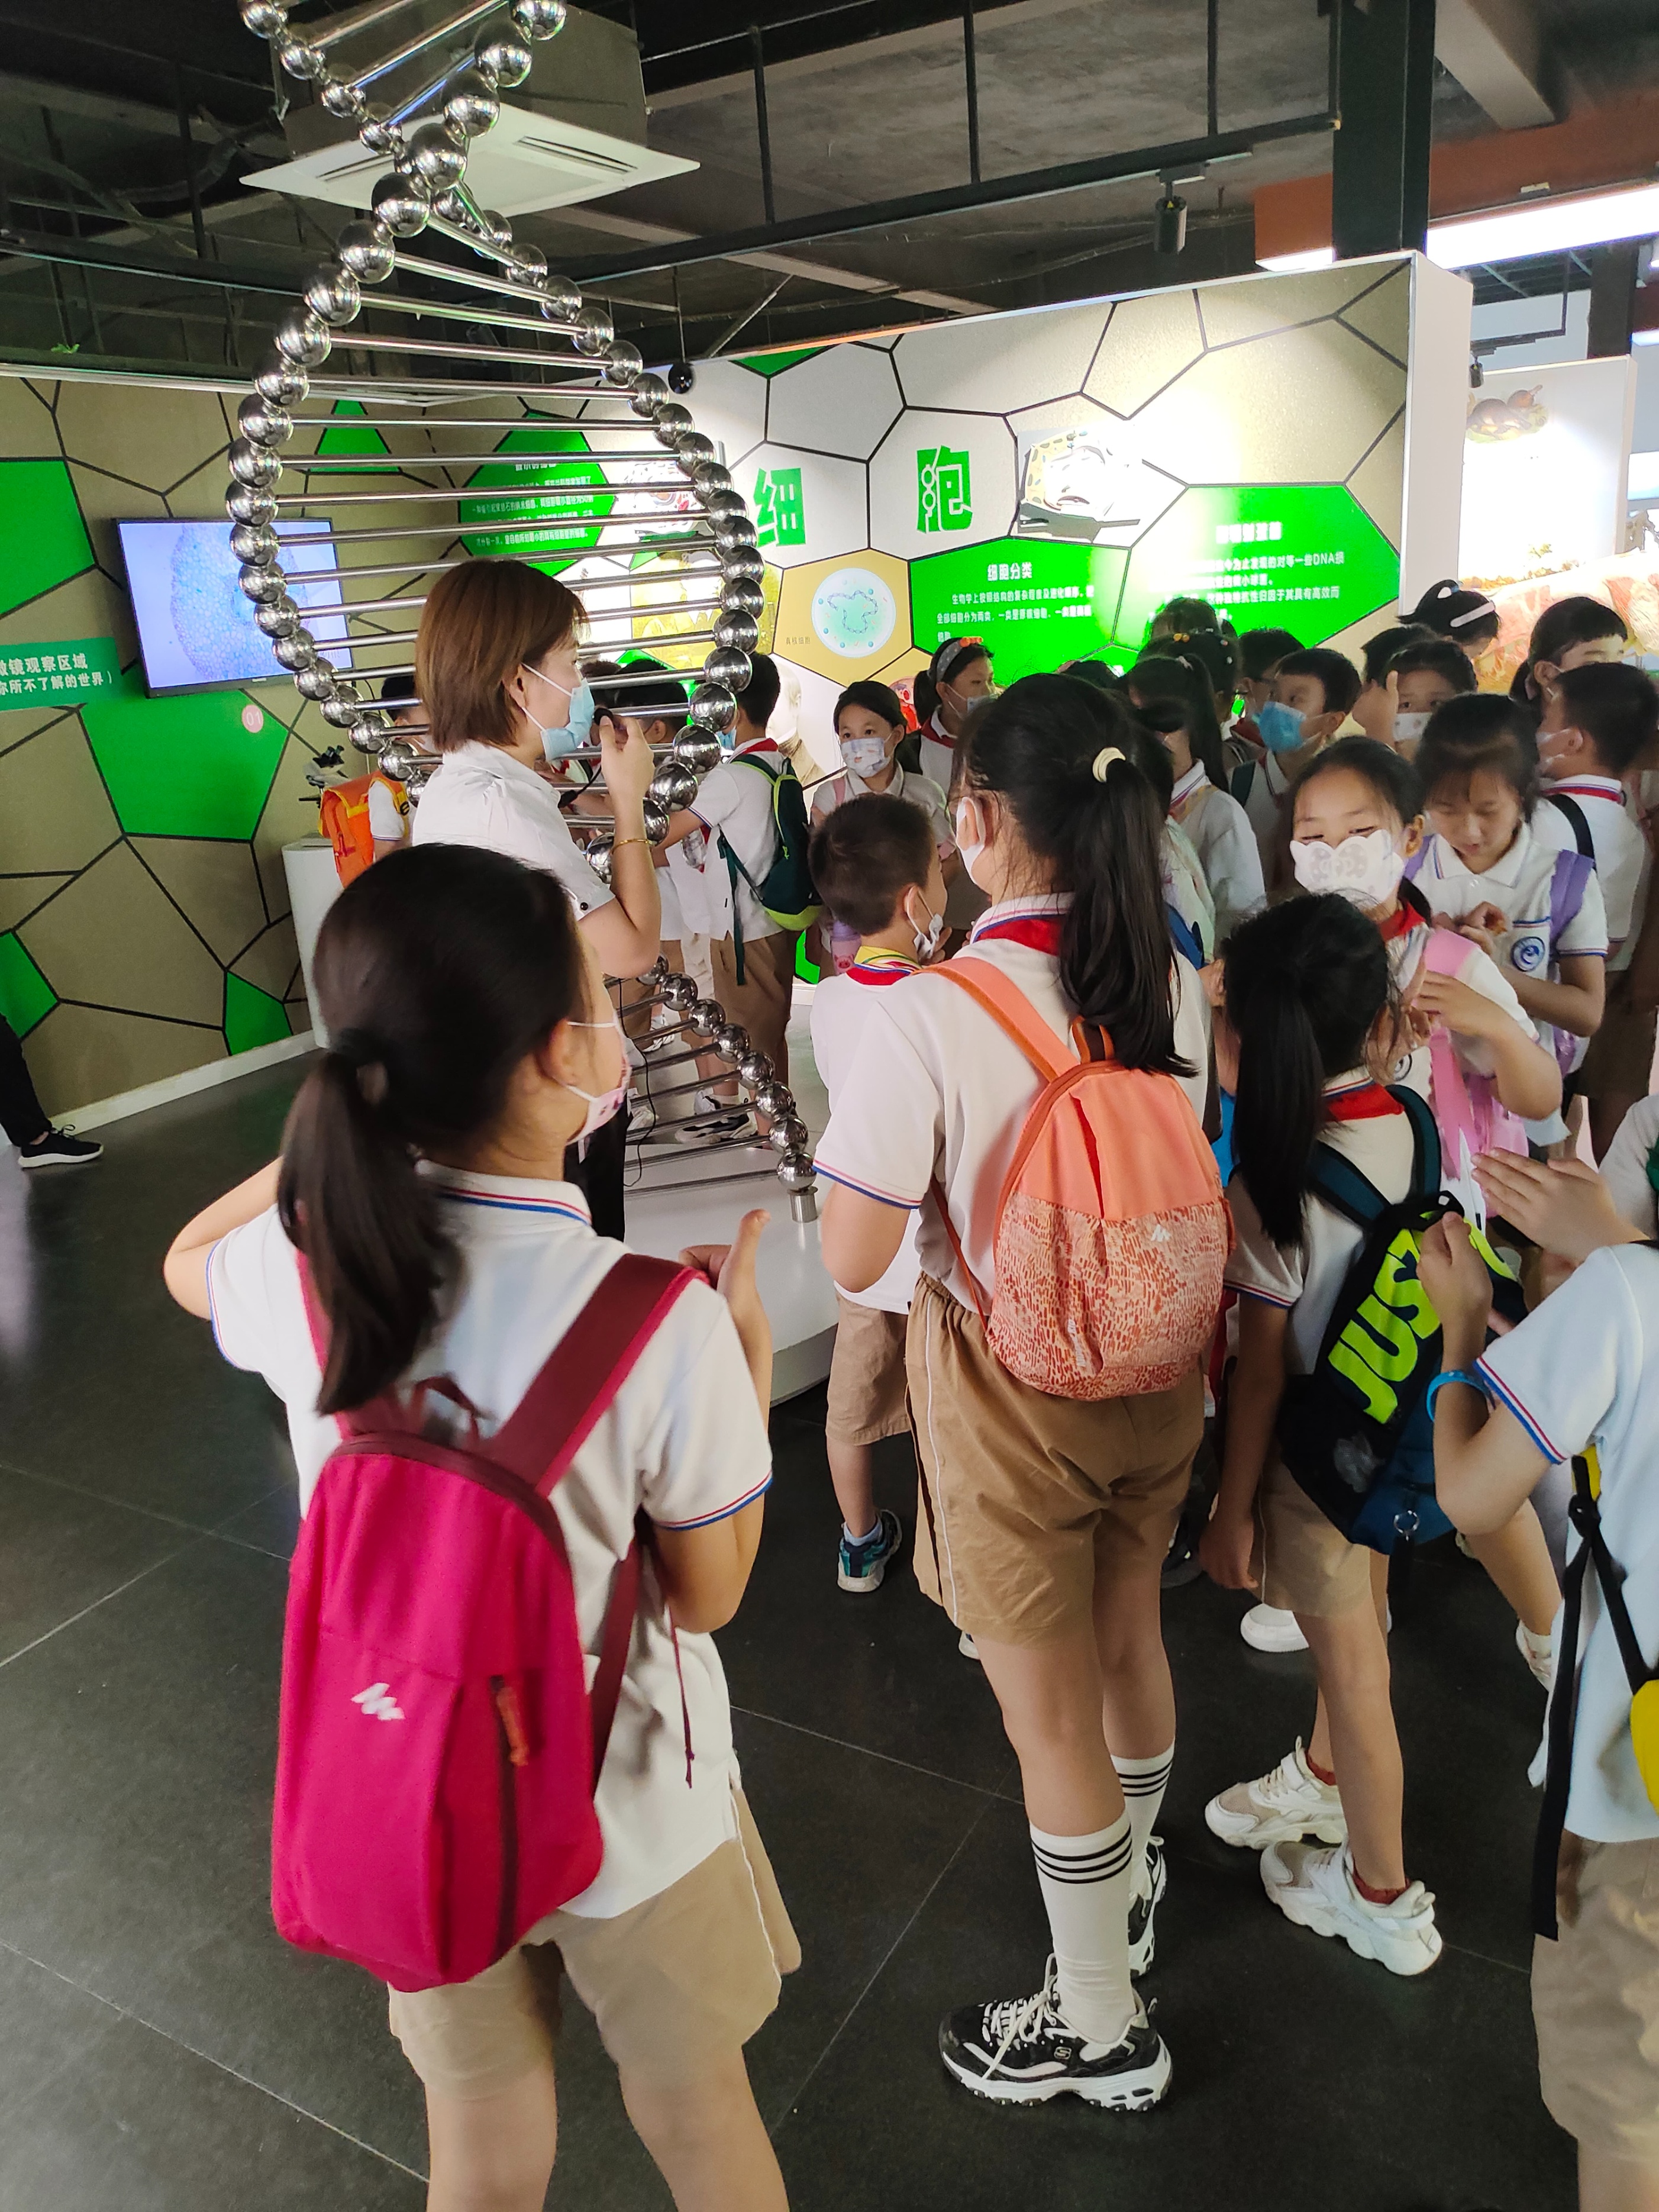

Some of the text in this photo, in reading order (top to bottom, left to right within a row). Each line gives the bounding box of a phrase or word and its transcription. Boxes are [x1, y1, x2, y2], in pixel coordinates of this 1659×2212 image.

[754, 445, 973, 548] 细 胞
[987, 562, 1033, 581] 细胞分类
[246, 711, 262, 727] 01
